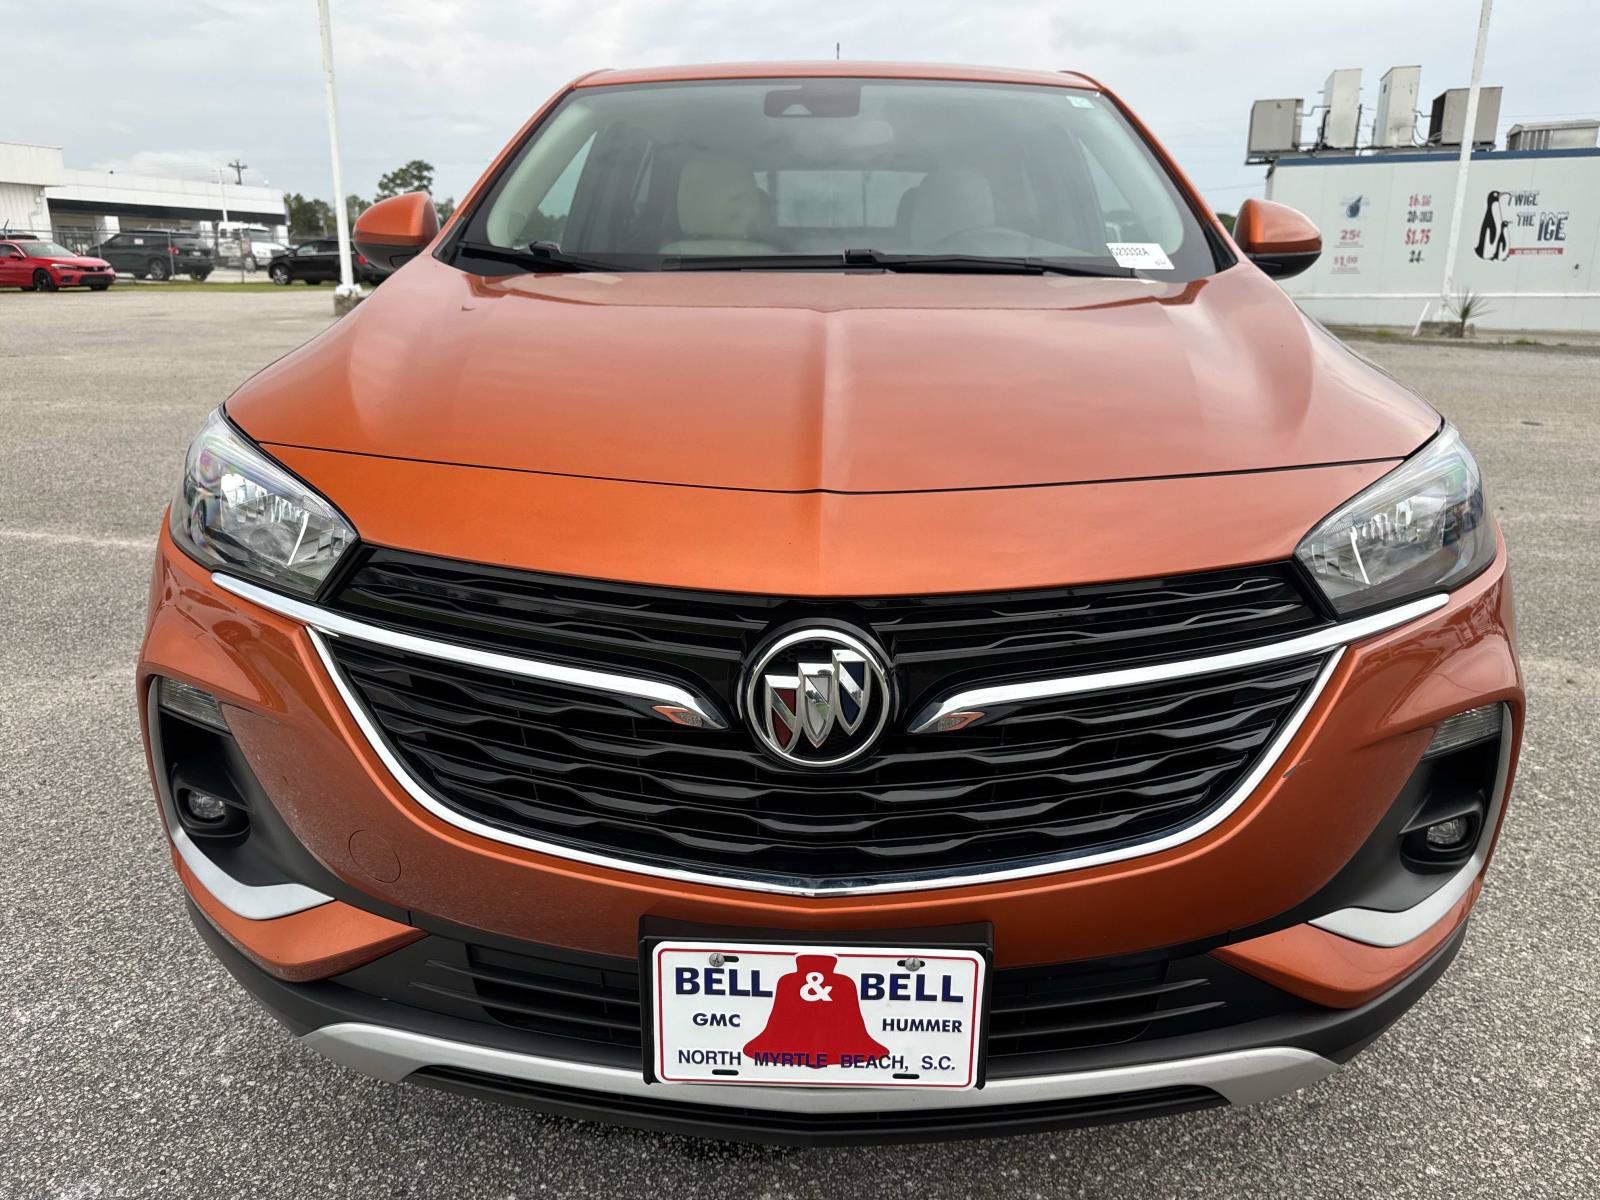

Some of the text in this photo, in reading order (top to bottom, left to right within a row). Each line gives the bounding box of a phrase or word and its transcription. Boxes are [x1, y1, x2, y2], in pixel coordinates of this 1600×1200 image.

[1508, 191, 1540, 206] TWICE
[1516, 212, 1569, 241] THE ICE
[675, 966, 964, 1003] BELL & BELL
[692, 1012, 741, 1028] GMC
[882, 1018, 963, 1033] HUMMER
[678, 1049, 956, 1072] NORTH MYRTLE BEACH, S.C.
